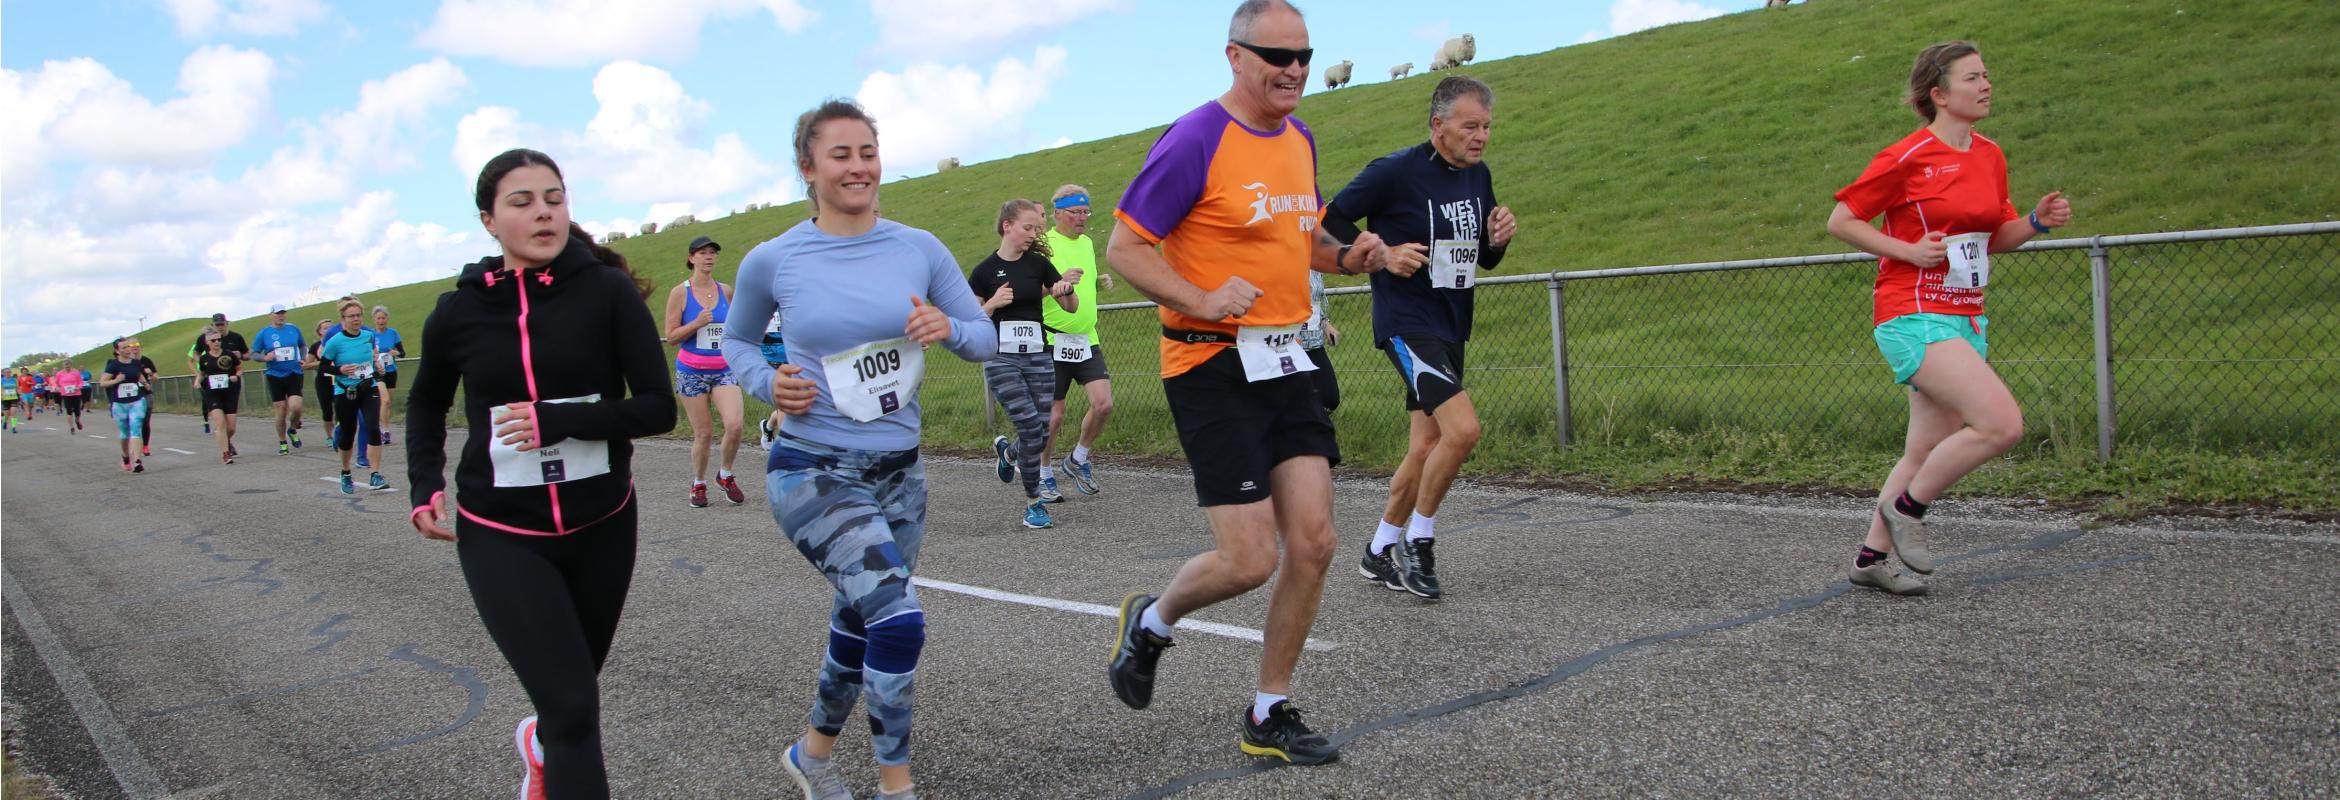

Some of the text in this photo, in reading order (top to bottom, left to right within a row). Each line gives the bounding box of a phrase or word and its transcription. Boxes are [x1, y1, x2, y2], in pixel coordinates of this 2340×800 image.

[1270, 194, 1291, 214] RUN
[1440, 199, 1474, 219] WES
[1449, 213, 1478, 232] TER
[1449, 247, 1477, 264] 1096
[706, 327, 723, 337] 1169
[1012, 326, 1034, 337] 1078
[1060, 347, 1085, 361] 5907
[852, 348, 901, 383] 1009
[868, 379, 900, 395] Elisavet
[540, 448, 560, 458] Neli
